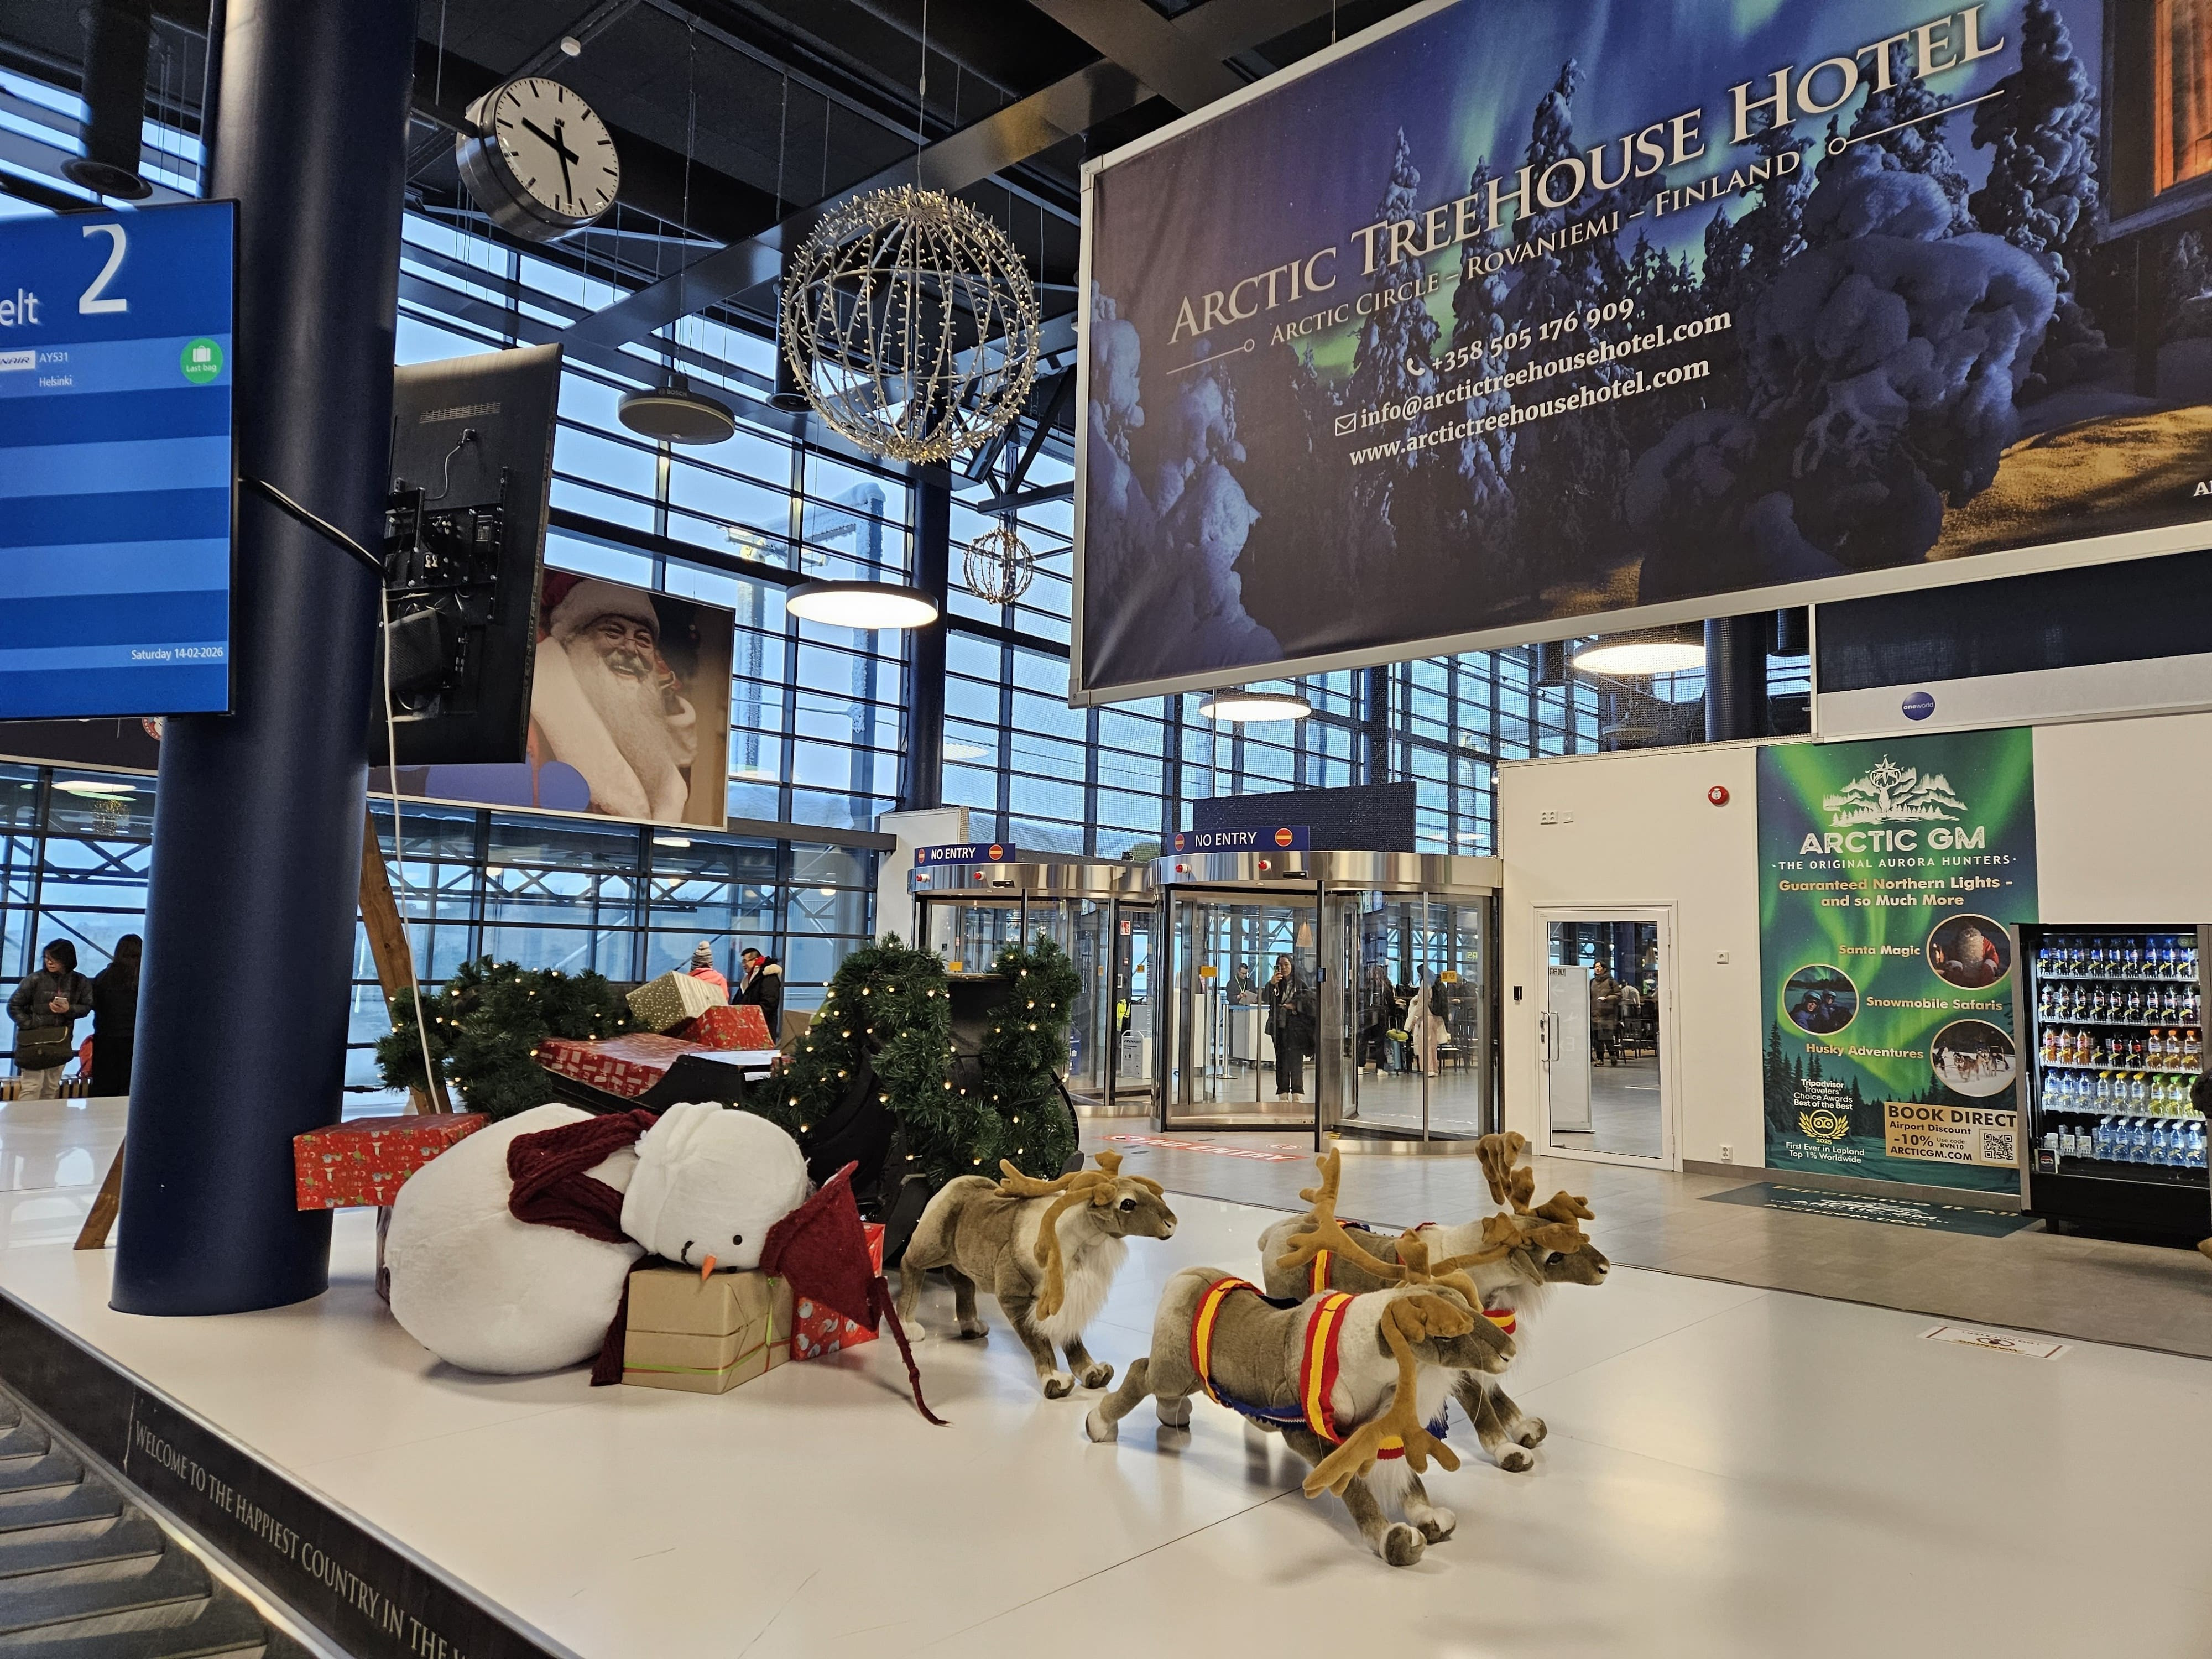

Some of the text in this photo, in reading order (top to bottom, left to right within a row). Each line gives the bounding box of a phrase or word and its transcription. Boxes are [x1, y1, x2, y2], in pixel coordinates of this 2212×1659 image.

[1167, 4, 2004, 346] ARCTIC TREEHOUSE HOTEL
[1271, 304, 1349, 346] ARCTIC
[1356, 273, 1439, 315] CIRCLE
[1468, 211, 1620, 280] ROVANIEMI
[1655, 151, 1800, 217] FINLAND
[79, 223, 127, 314] 2
[0, 288, 38, 326] elt
[1432, 298, 1634, 372] +358 505 176 909
[39, 352, 68, 363] AY531
[202, 363, 217, 373] bag
[1361, 312, 1732, 428] info@arctictreehousehotel.com
[39, 375, 72, 387] Helsinki
[1349, 360, 1710, 465] www.arctictreehousehotel.com
[2193, 480, 2212, 497] A
[132, 646, 223, 661] Saturday 14-02-2026
[1195, 832, 1257, 847] NO ENTRY
[1799, 826, 1985, 854] ARCTIC GM
[931, 847, 976, 860] NO ENTRY
[1778, 855, 2010, 870] THE ORIGINAL AURORA HUNTERS
[1779, 879, 1867, 892] Guaranteed
[1873, 878, 1945, 890] Northern
[1950, 877, 2000, 892] Lights
[1821, 894, 1964, 907] and so Much More
[1839, 945, 1921, 957] Santa Magic
[1866, 997, 2003, 1011] Snowmobile Safaris
[1806, 1043, 1924, 1060] Husky Adventures
[1801, 1079, 1845, 1088] Tripadvisor
[1794, 1092, 1822, 1100] Choice
[1888, 1105, 2017, 1128] BOOK DIRECT
[1890, 1121, 1971, 1134] Airport Discount
[1893, 1134, 1934, 1147] -10%
[1186, 1145, 1296, 1160] ENTRY
[1789, 1150, 1861, 1164] Top 1% Worldwide
[1804, 1144, 1820, 1152] Ever
[1833, 1146, 1865, 1156] Lapland
[1890, 1146, 1973, 1161] ARCTICGM.COM
[135, 1420, 447, 1659] WELCOME TO THE HAPPIEST COUNTRY IN THE
